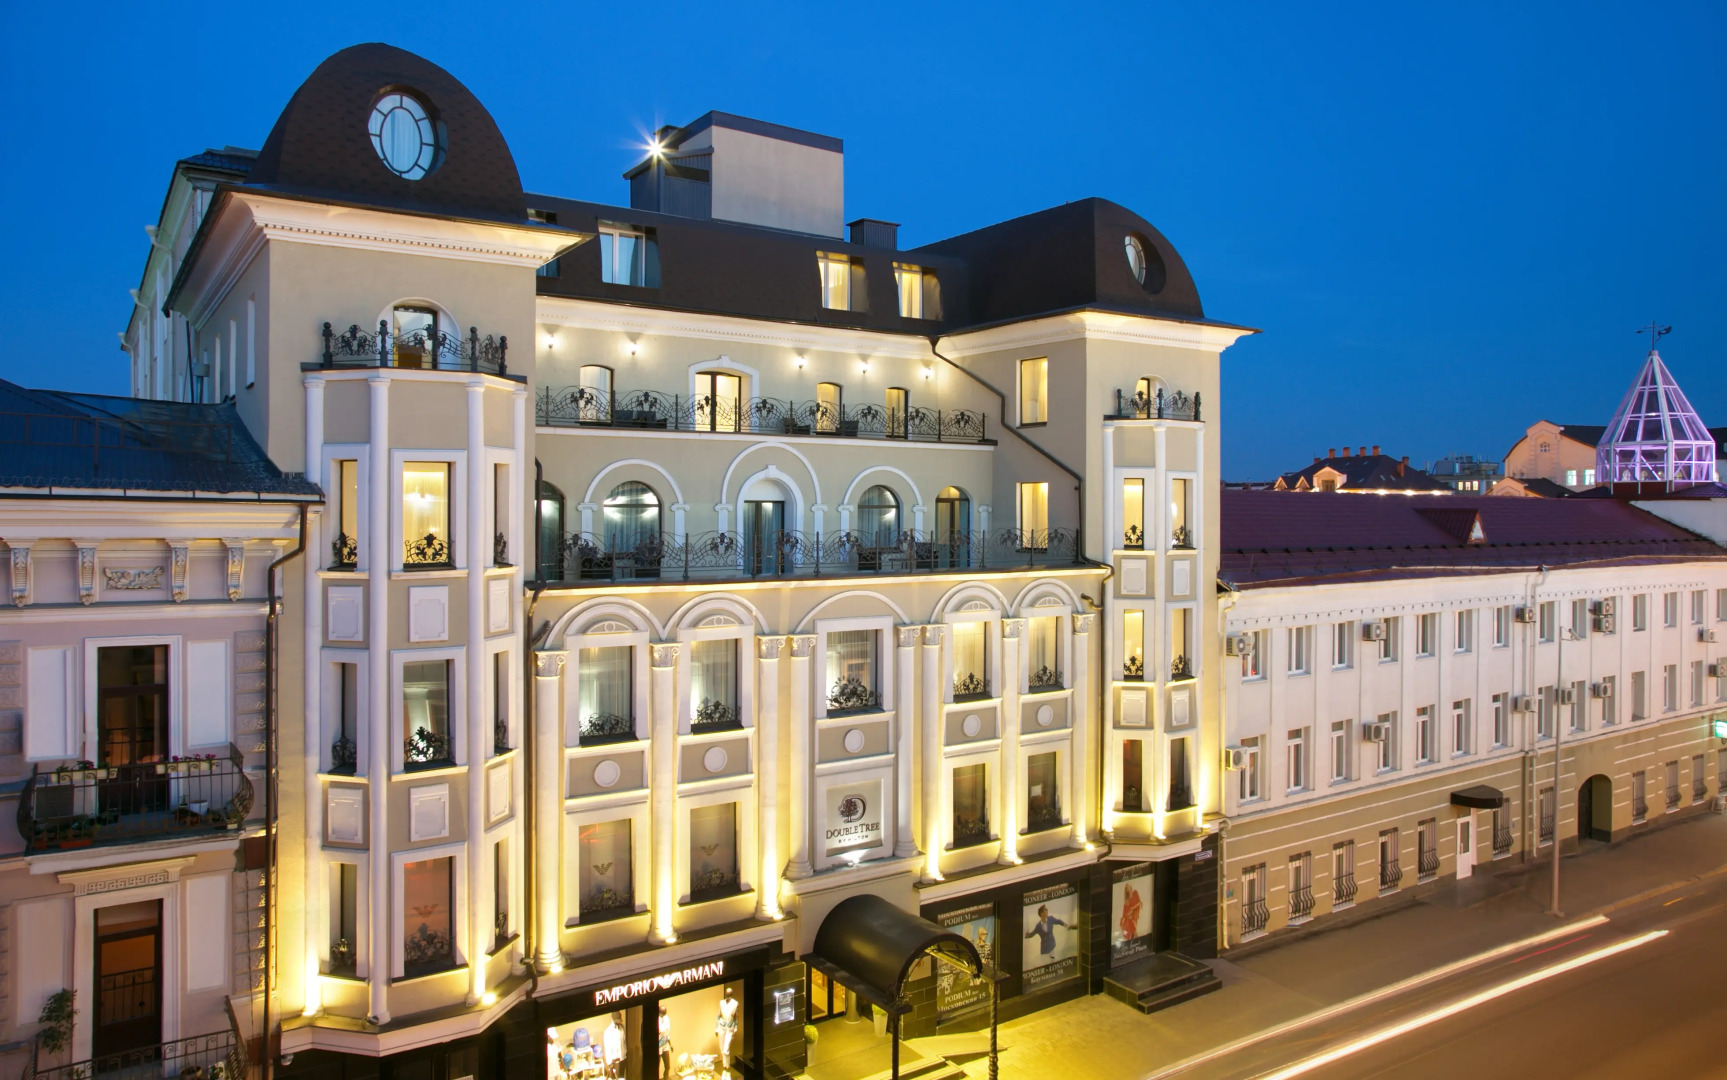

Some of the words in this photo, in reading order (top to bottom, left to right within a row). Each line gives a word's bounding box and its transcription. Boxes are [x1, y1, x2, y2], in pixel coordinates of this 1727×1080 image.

[944, 913, 971, 926] PODIUM
[594, 977, 657, 1006] EMPORIO
[674, 961, 724, 986] ARMANI
[944, 990, 971, 1004] PODIUM
